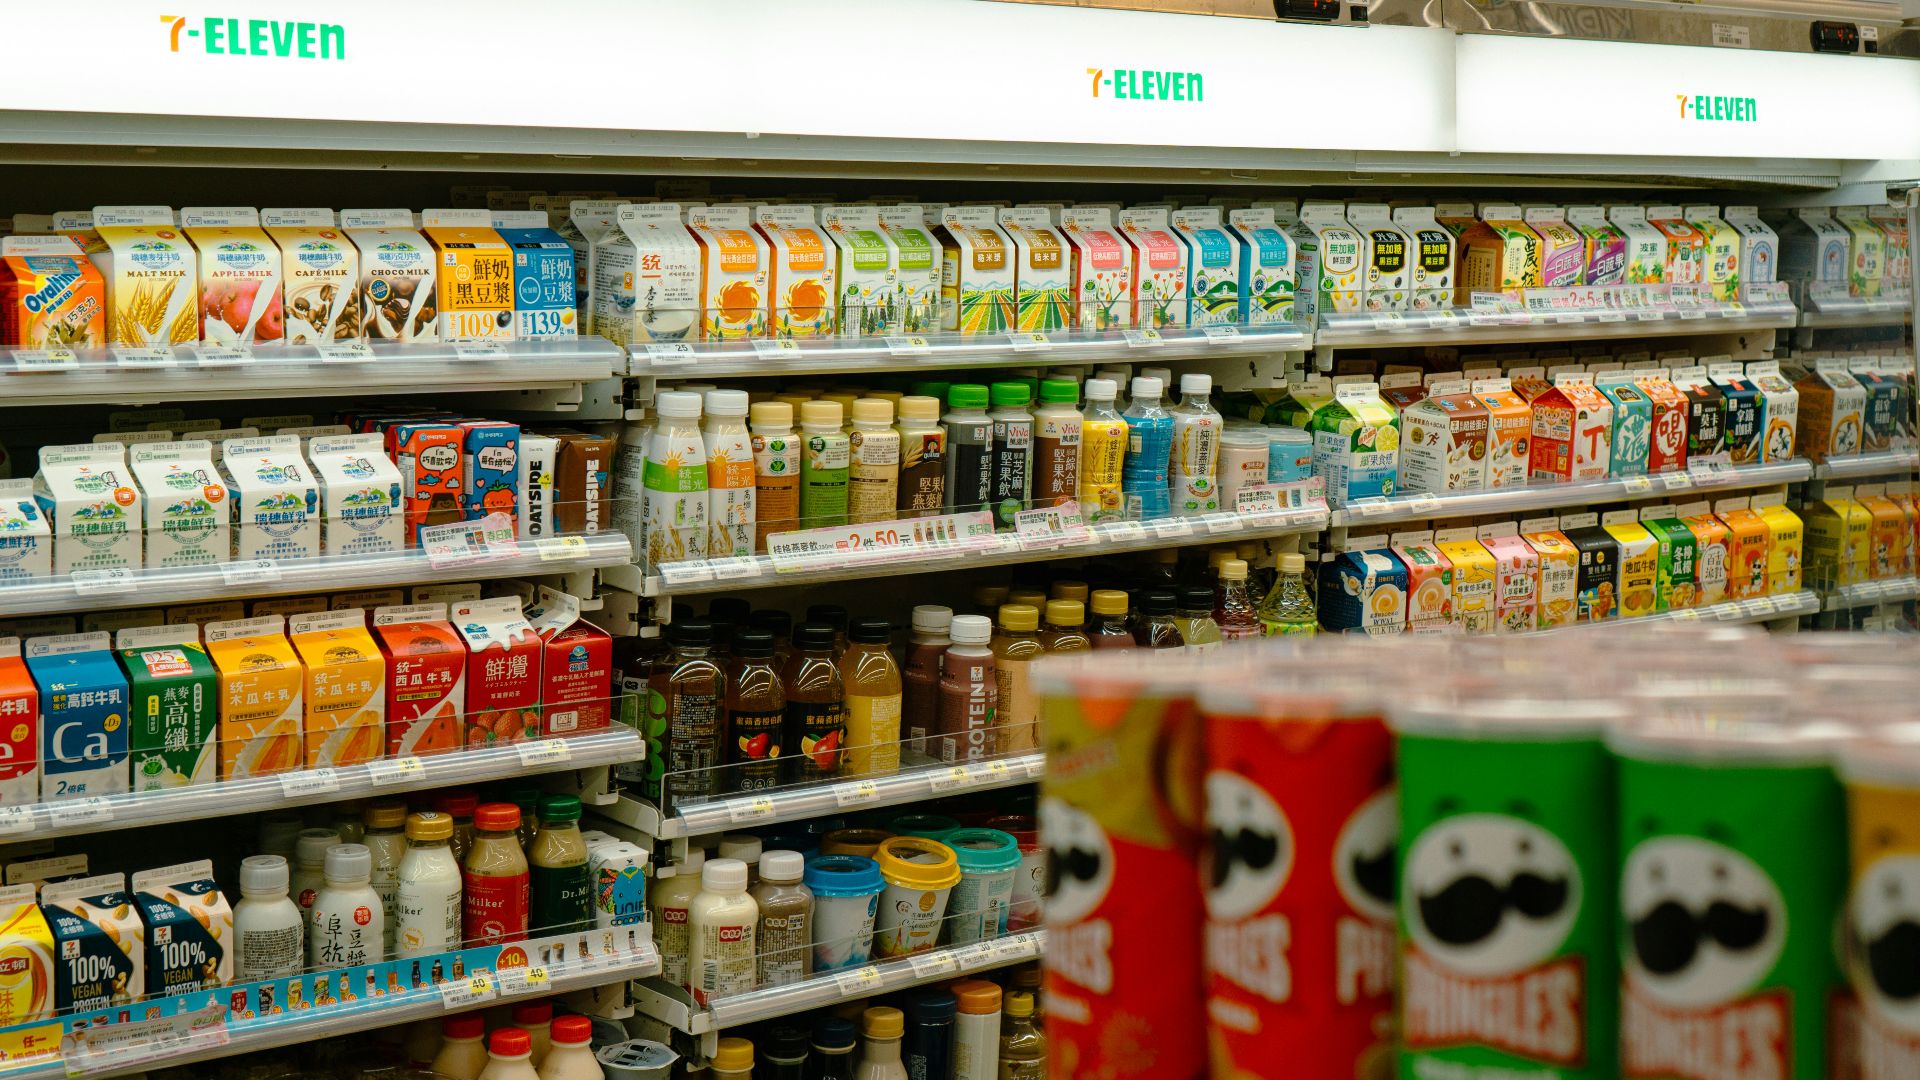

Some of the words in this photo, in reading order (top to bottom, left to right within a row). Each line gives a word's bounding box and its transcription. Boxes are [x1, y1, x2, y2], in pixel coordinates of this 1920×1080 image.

[1328, 243, 1356, 255] 無加糖
[1376, 244, 1402, 255] 無加糖
[1422, 243, 1448, 255] 無加糖
[474, 258, 511, 281] 鮮奶
[541, 258, 573, 281] 鮮奶
[641, 254, 662, 279] 統一
[1545, 253, 1581, 273] 一日蔬果
[1587, 254, 1624, 276] 一日蔬果
[127, 269, 159, 277] MALT
[161, 269, 187, 277] MILK
[212, 270, 244, 278] APPLE
[248, 269, 273, 277] MILK
[324, 269, 348, 277] MILK
[456, 283, 511, 305] 黑豆漿
[543, 281, 574, 304] 豆漿
[67, 296, 96, 324] 巧克力
[457, 312, 495, 338] 10.9
[529, 312, 561, 337] 13.9
[676, 344, 688, 352] 25
[998, 451, 1013, 497] 堅果飲
[1012, 459, 1025, 490] 芝麻
[1051, 448, 1067, 494] 堅果飲
[1064, 457, 1077, 487] 綜合
[528, 460, 543, 537] OATSIDE
[585, 459, 600, 535] OATSIDE
[341, 505, 391, 520] 瑞穗鮮乳
[1624, 558, 1656, 574] 地瓜牛奶
[396, 661, 422, 674] 統一
[485, 655, 528, 682] 鮮攪
[230, 681, 257, 694] 統一
[314, 671, 342, 688] 統一
[395, 671, 452, 687] 西瓜牛乳
[163, 686, 190, 702] 燕麥
[230, 688, 290, 706] 木瓜牛乳
[314, 680, 373, 697] 木瓜牛乳
[0, 698, 29, 716] 牛乳
[67, 688, 122, 711] 高鈣牛乳
[163, 702, 191, 753] 高纖
[967, 683, 986, 765] ROTEIN
[52, 722, 109, 764] Ca
[56, 781, 87, 797] 2倍鈣
[148, 902, 172, 915] 100%
[57, 917, 80, 927] 100%
[161, 942, 206, 971] 100%
[69, 954, 116, 985] 100%
[164, 970, 194, 984] VEGAN
[529, 968, 544, 979] 40
[72, 984, 102, 998] VEGAN
[164, 980, 201, 998] PROTEIN
[472, 978, 486, 989] 40
[73, 996, 110, 1015] PROTEIN
[23, 1035, 48, 1050] 任一
